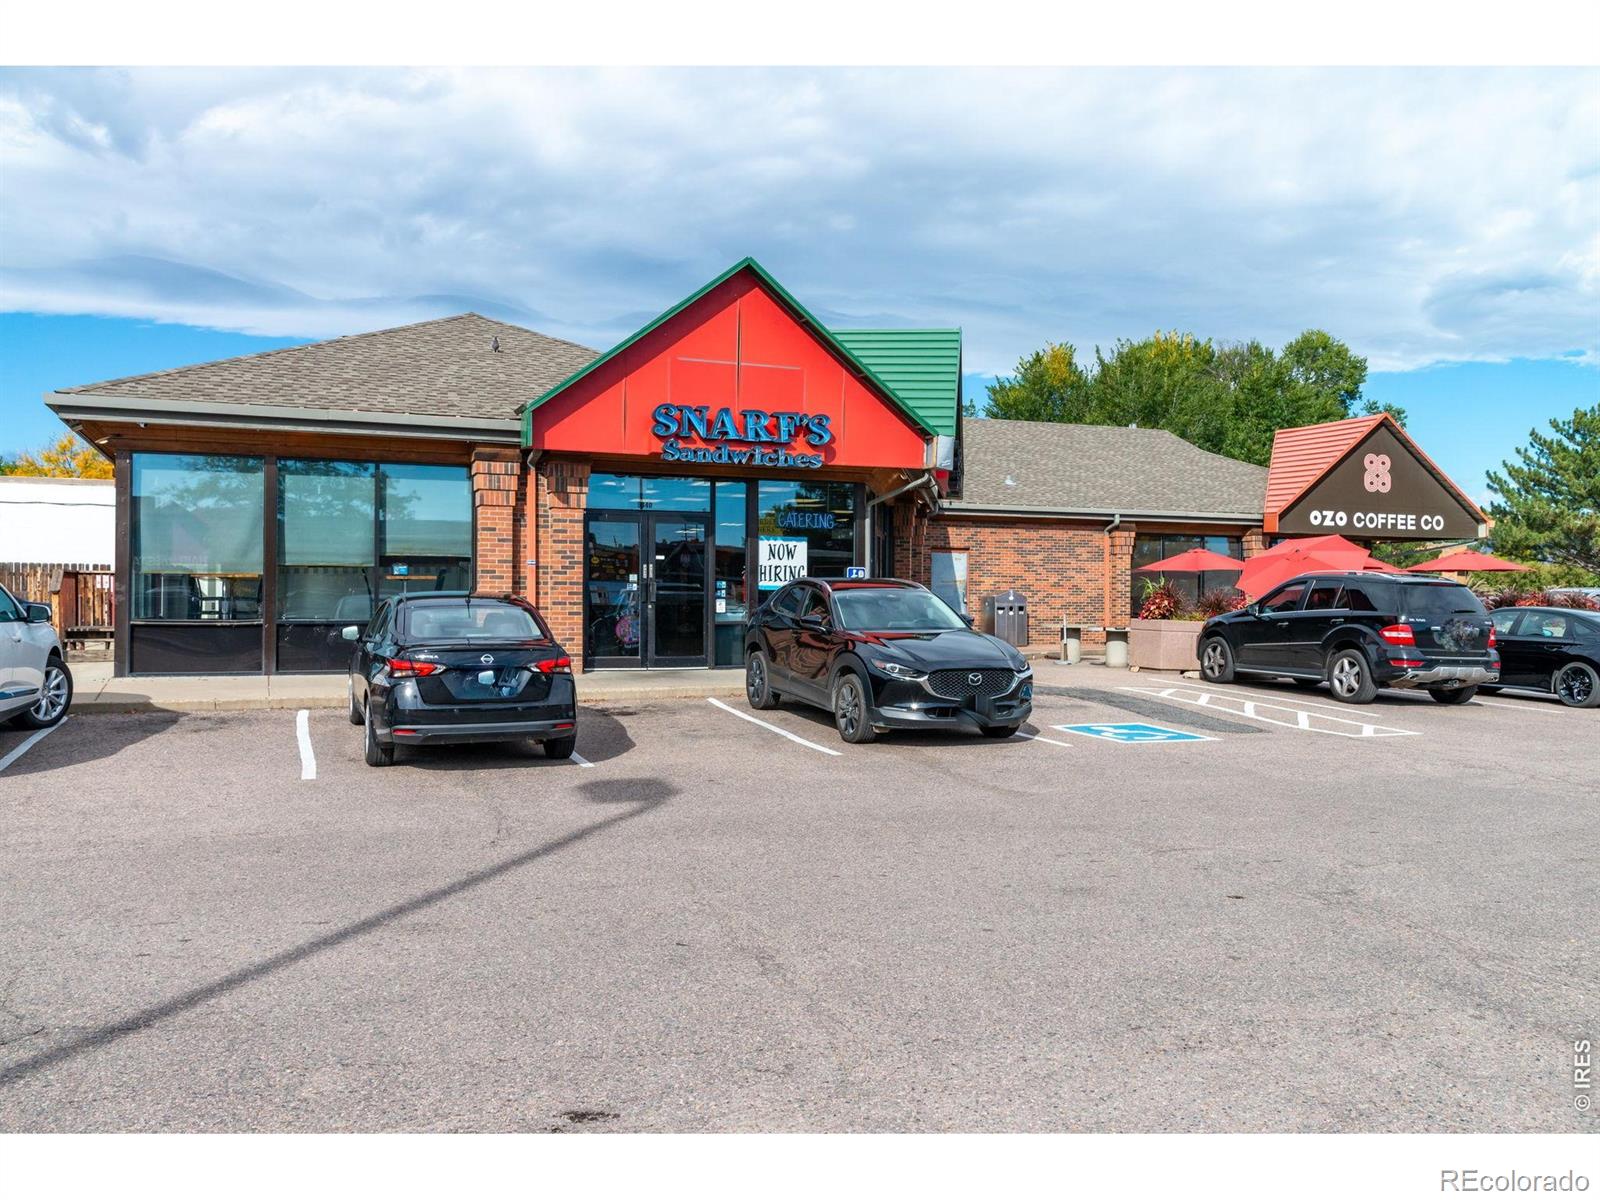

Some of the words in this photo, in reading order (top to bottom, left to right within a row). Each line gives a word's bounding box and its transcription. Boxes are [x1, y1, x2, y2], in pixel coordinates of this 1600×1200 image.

[652, 403, 832, 446] SNARF'S
[661, 438, 823, 468] Sandwiches
[778, 511, 835, 529] CATERING
[1309, 510, 1348, 527] OZO
[1353, 512, 1417, 530] COFFEE
[1420, 514, 1445, 531] CO
[767, 543, 798, 561] NOW
[759, 564, 806, 582] HIRING
